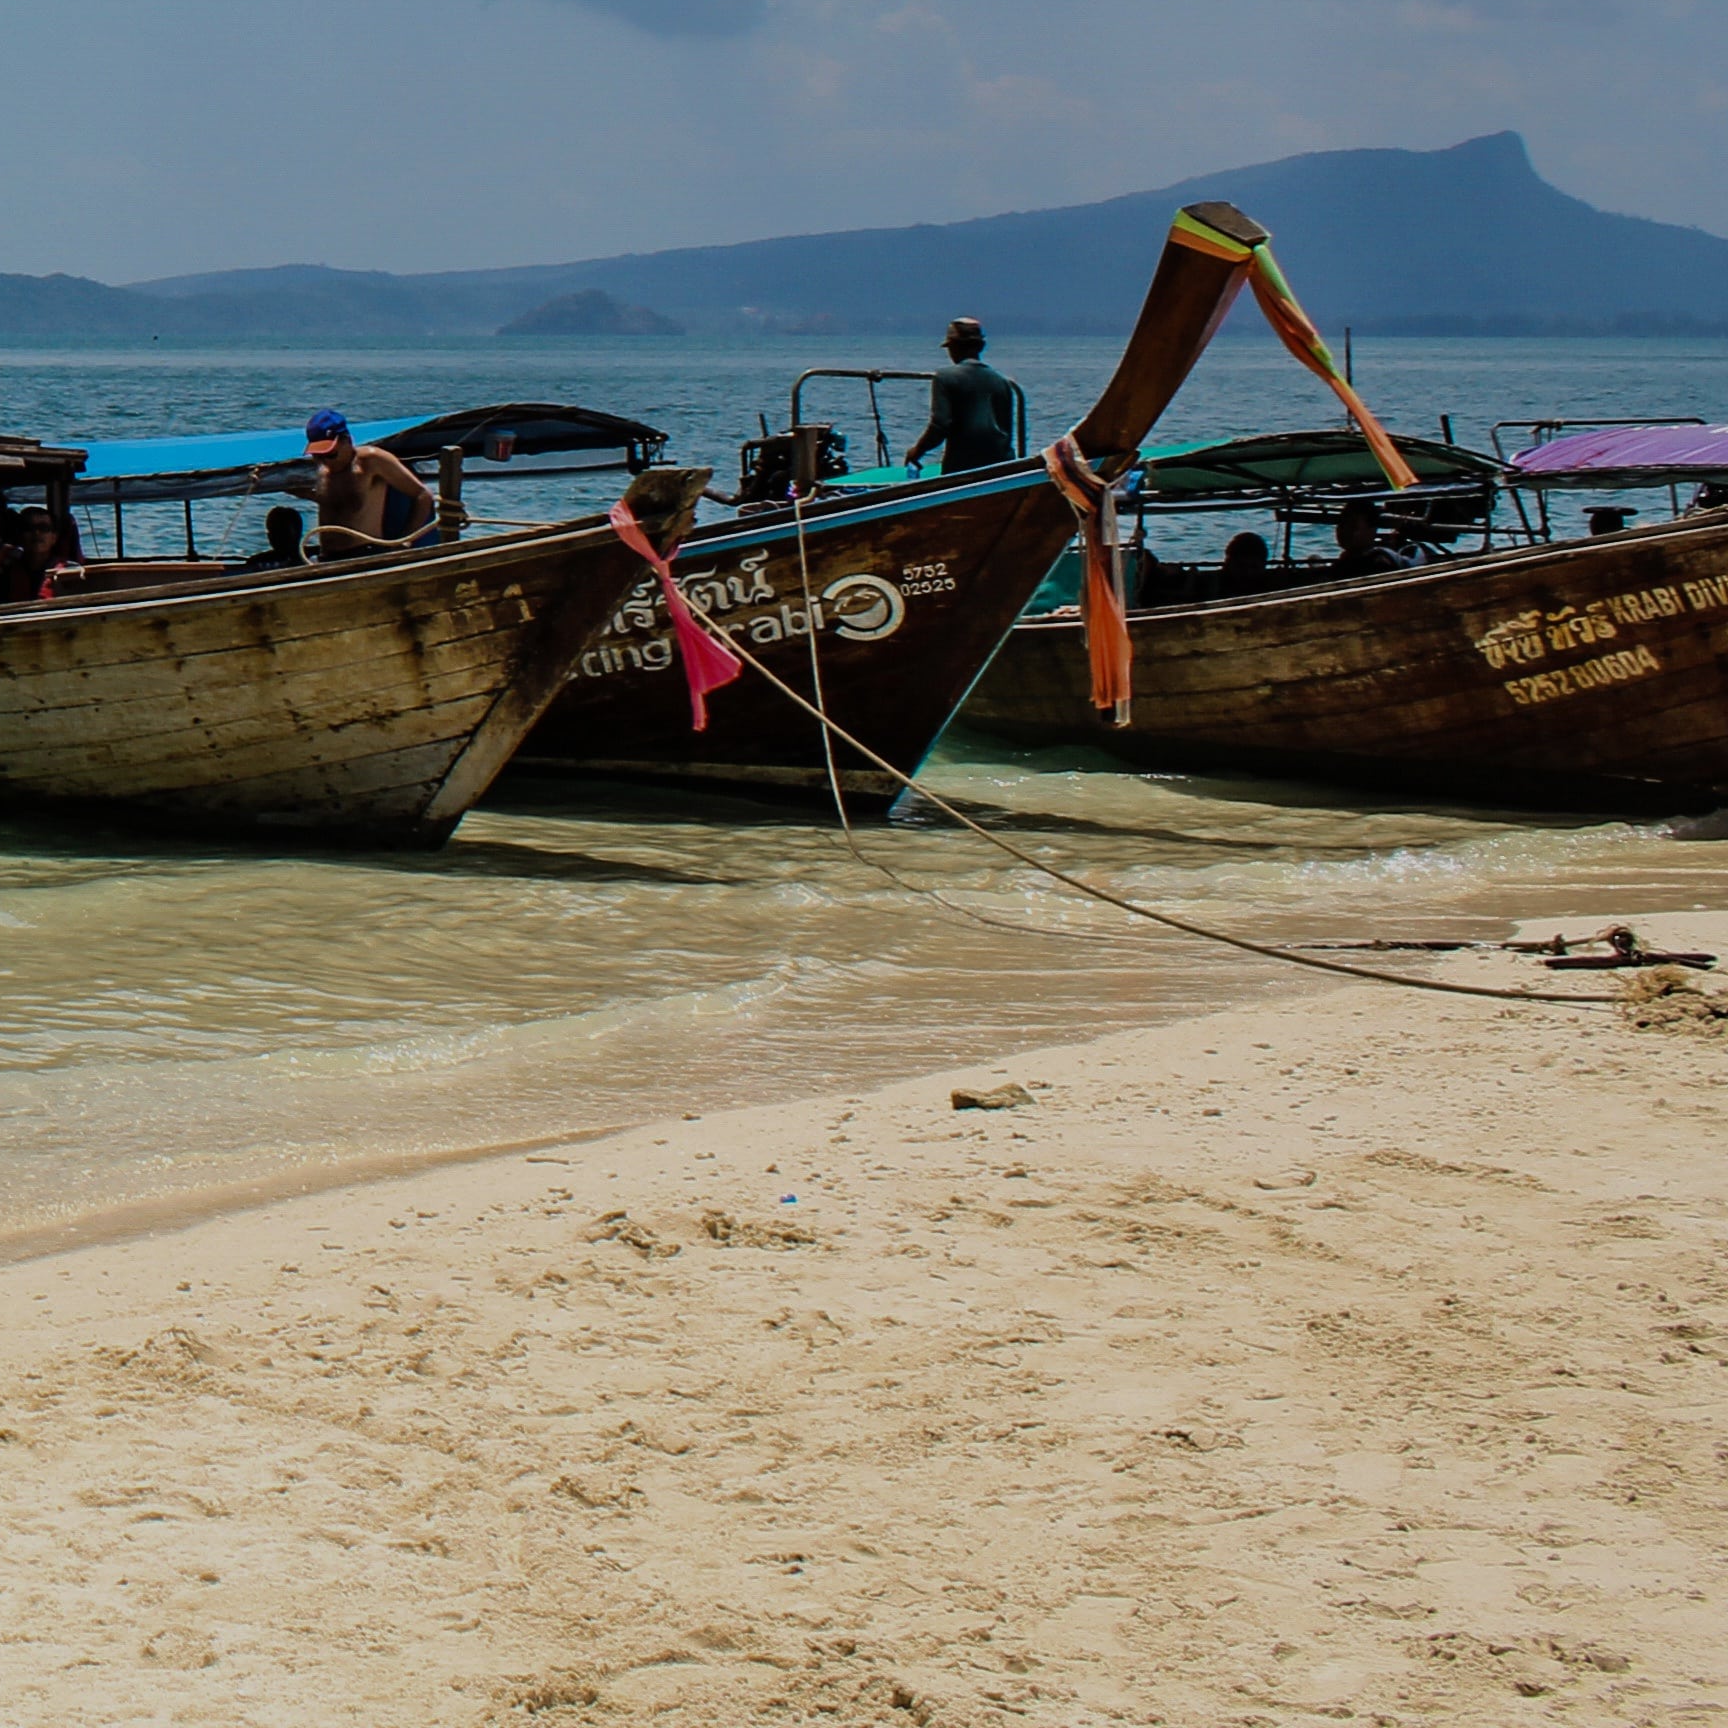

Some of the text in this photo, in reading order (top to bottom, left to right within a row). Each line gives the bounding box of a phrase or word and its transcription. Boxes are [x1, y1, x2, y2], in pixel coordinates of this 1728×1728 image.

[901, 578, 956, 597] 02525
[902, 563, 948, 581] 5752
[1606, 575, 1728, 625] KRABI DIV
[710, 594, 825, 648] rabi
[566, 638, 673, 677] cing
